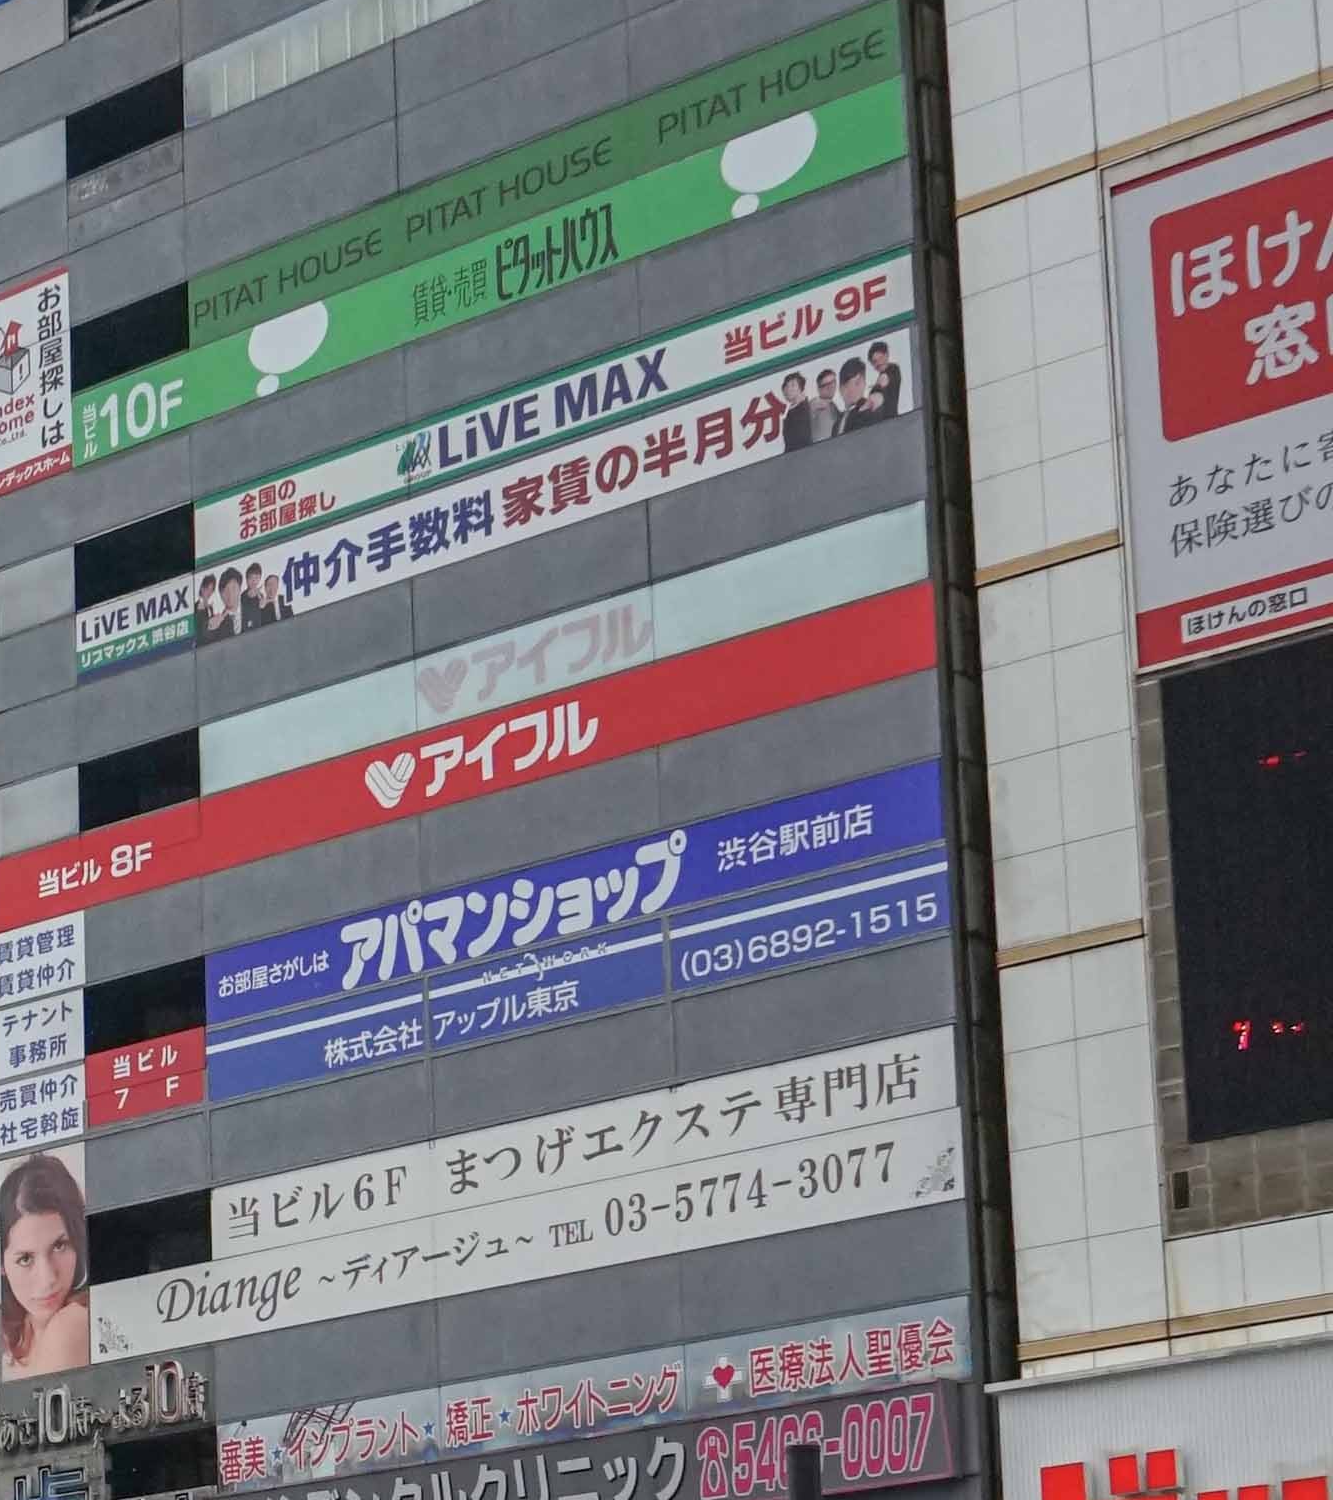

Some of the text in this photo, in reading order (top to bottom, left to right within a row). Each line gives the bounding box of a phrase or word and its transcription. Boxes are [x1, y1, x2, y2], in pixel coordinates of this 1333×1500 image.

[657, 28, 886, 145] PITAT HOUSE
[406, 135, 613, 243] PITAT HOUSE
[194, 228, 382, 329] PITAT HOUSE
[413, 202, 620, 327] 賃貸・売買 ピタットハウス
[724, 276, 886, 364] 当ビル 9F
[1243, 299, 1333, 386] 窓
[36, 282, 65, 449] お部屋探しは
[437, 347, 669, 469] LiVE MAX
[82, 378, 184, 460] 当ビル 10F
[238, 479, 297, 515] 全国の
[239, 491, 336, 541] お部屋探し
[282, 389, 786, 599] 仲介手数料 家賃の半月分
[136, 585, 190, 626] MAX
[1186, 587, 1309, 637] ほけんの窓口
[471, 602, 654, 701] アイフル
[420, 700, 599, 798] アイフル
[37, 841, 153, 899] 当ビル 8F
[217, 803, 874, 999] お部屋さがしは アパマンショップ 渋谷駅前店
[680, 892, 939, 980] (03)6892-1515
[2, 1000, 73, 1037] テナント
[8, 1033, 68, 1069] 事務所
[112, 1044, 178, 1080] 当ビル
[323, 978, 580, 1069] 株式会社 アップル東京
[115, 1076, 180, 1109] 7 F
[226, 1163, 408, 1242] 当ビル6F
[548, 1139, 897, 1248] TEL 03-5774-3077
[156, 1255, 302, 1327] Diange
[220, 1316, 955, 1486] 審美 インプラント 矯正 ホワイトニング 医療法人聖優会
